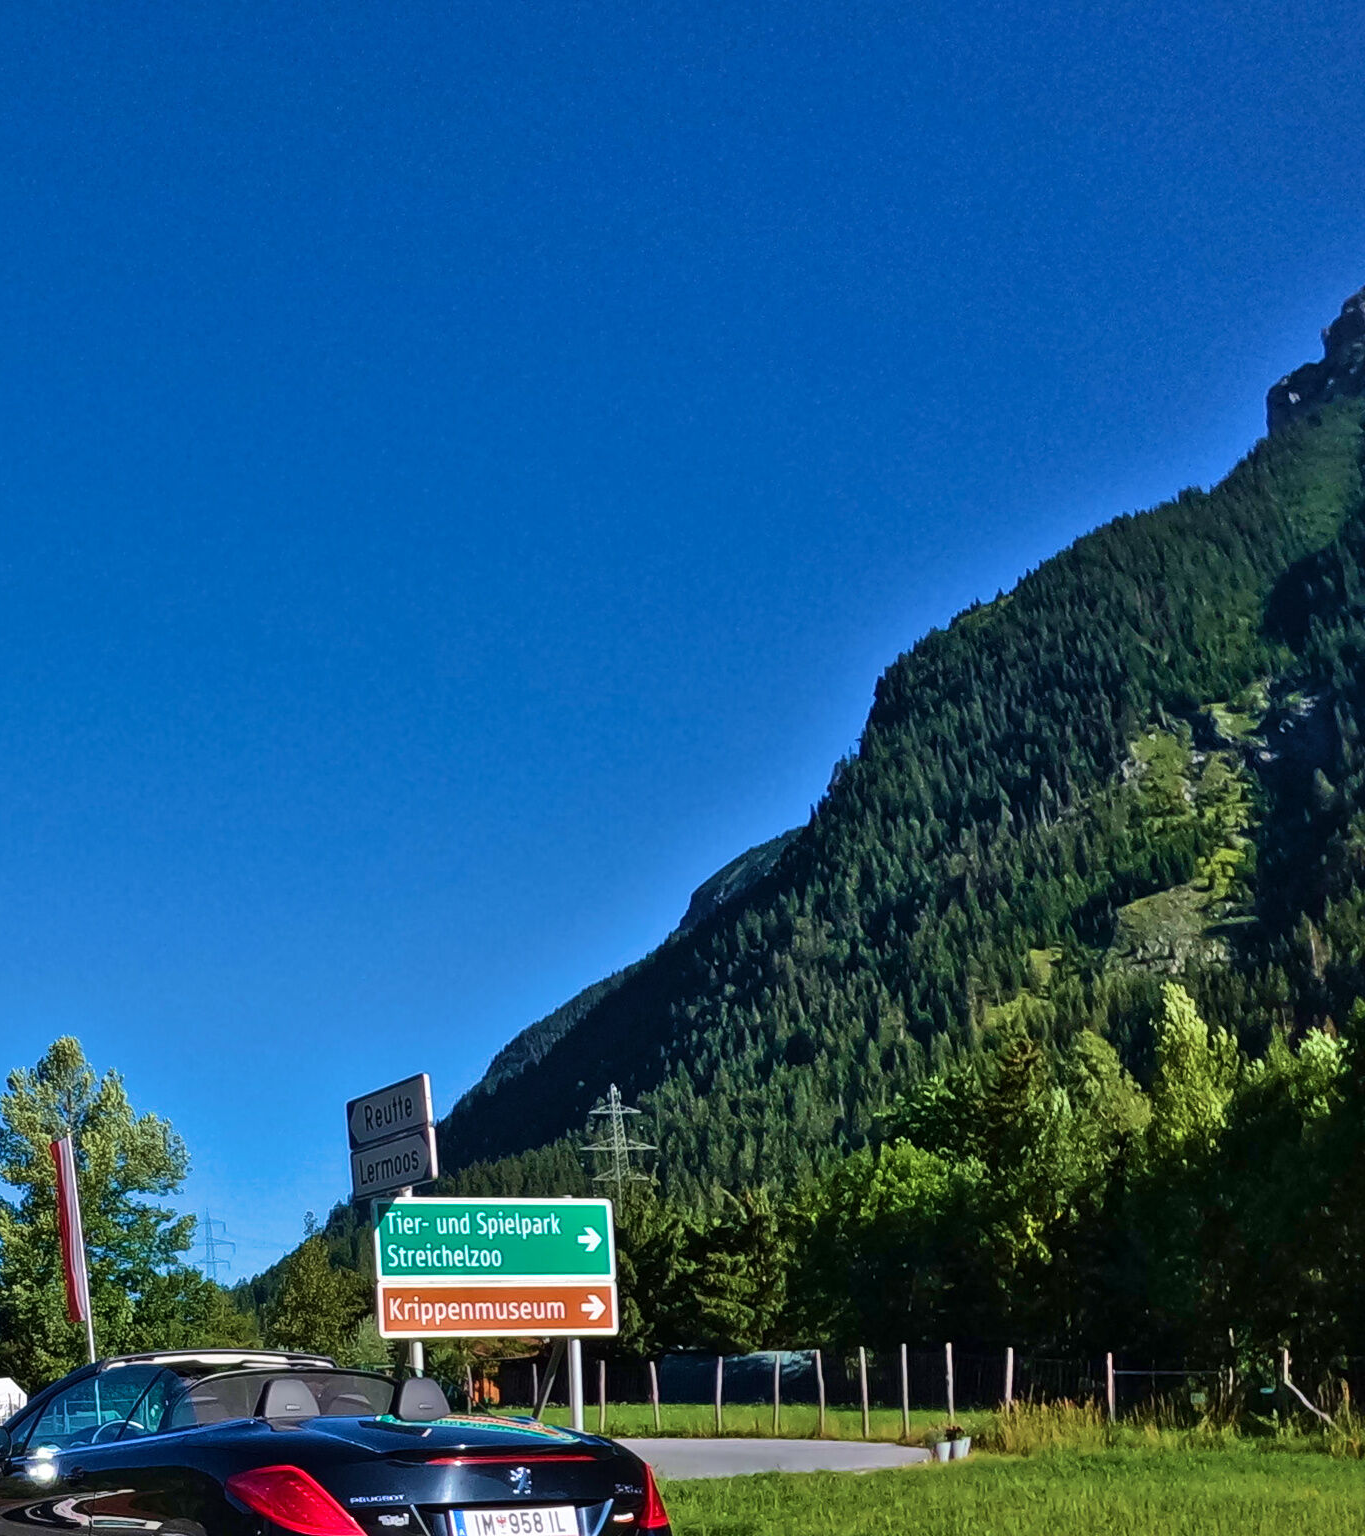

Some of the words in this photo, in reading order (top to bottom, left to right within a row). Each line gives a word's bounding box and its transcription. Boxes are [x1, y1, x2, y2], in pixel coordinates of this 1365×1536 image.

[364, 1095, 413, 1132] Reutte
[359, 1148, 420, 1186] Lermoos
[386, 1211, 429, 1235] Tier-
[437, 1213, 471, 1235] und
[476, 1211, 562, 1240] Spielpark
[387, 1244, 502, 1268] Streichelzoo
[388, 1295, 566, 1326] Krippenmuseum
[475, 1514, 496, 1536] IM
[509, 1512, 544, 1535] 958
[550, 1511, 567, 1533] IL
